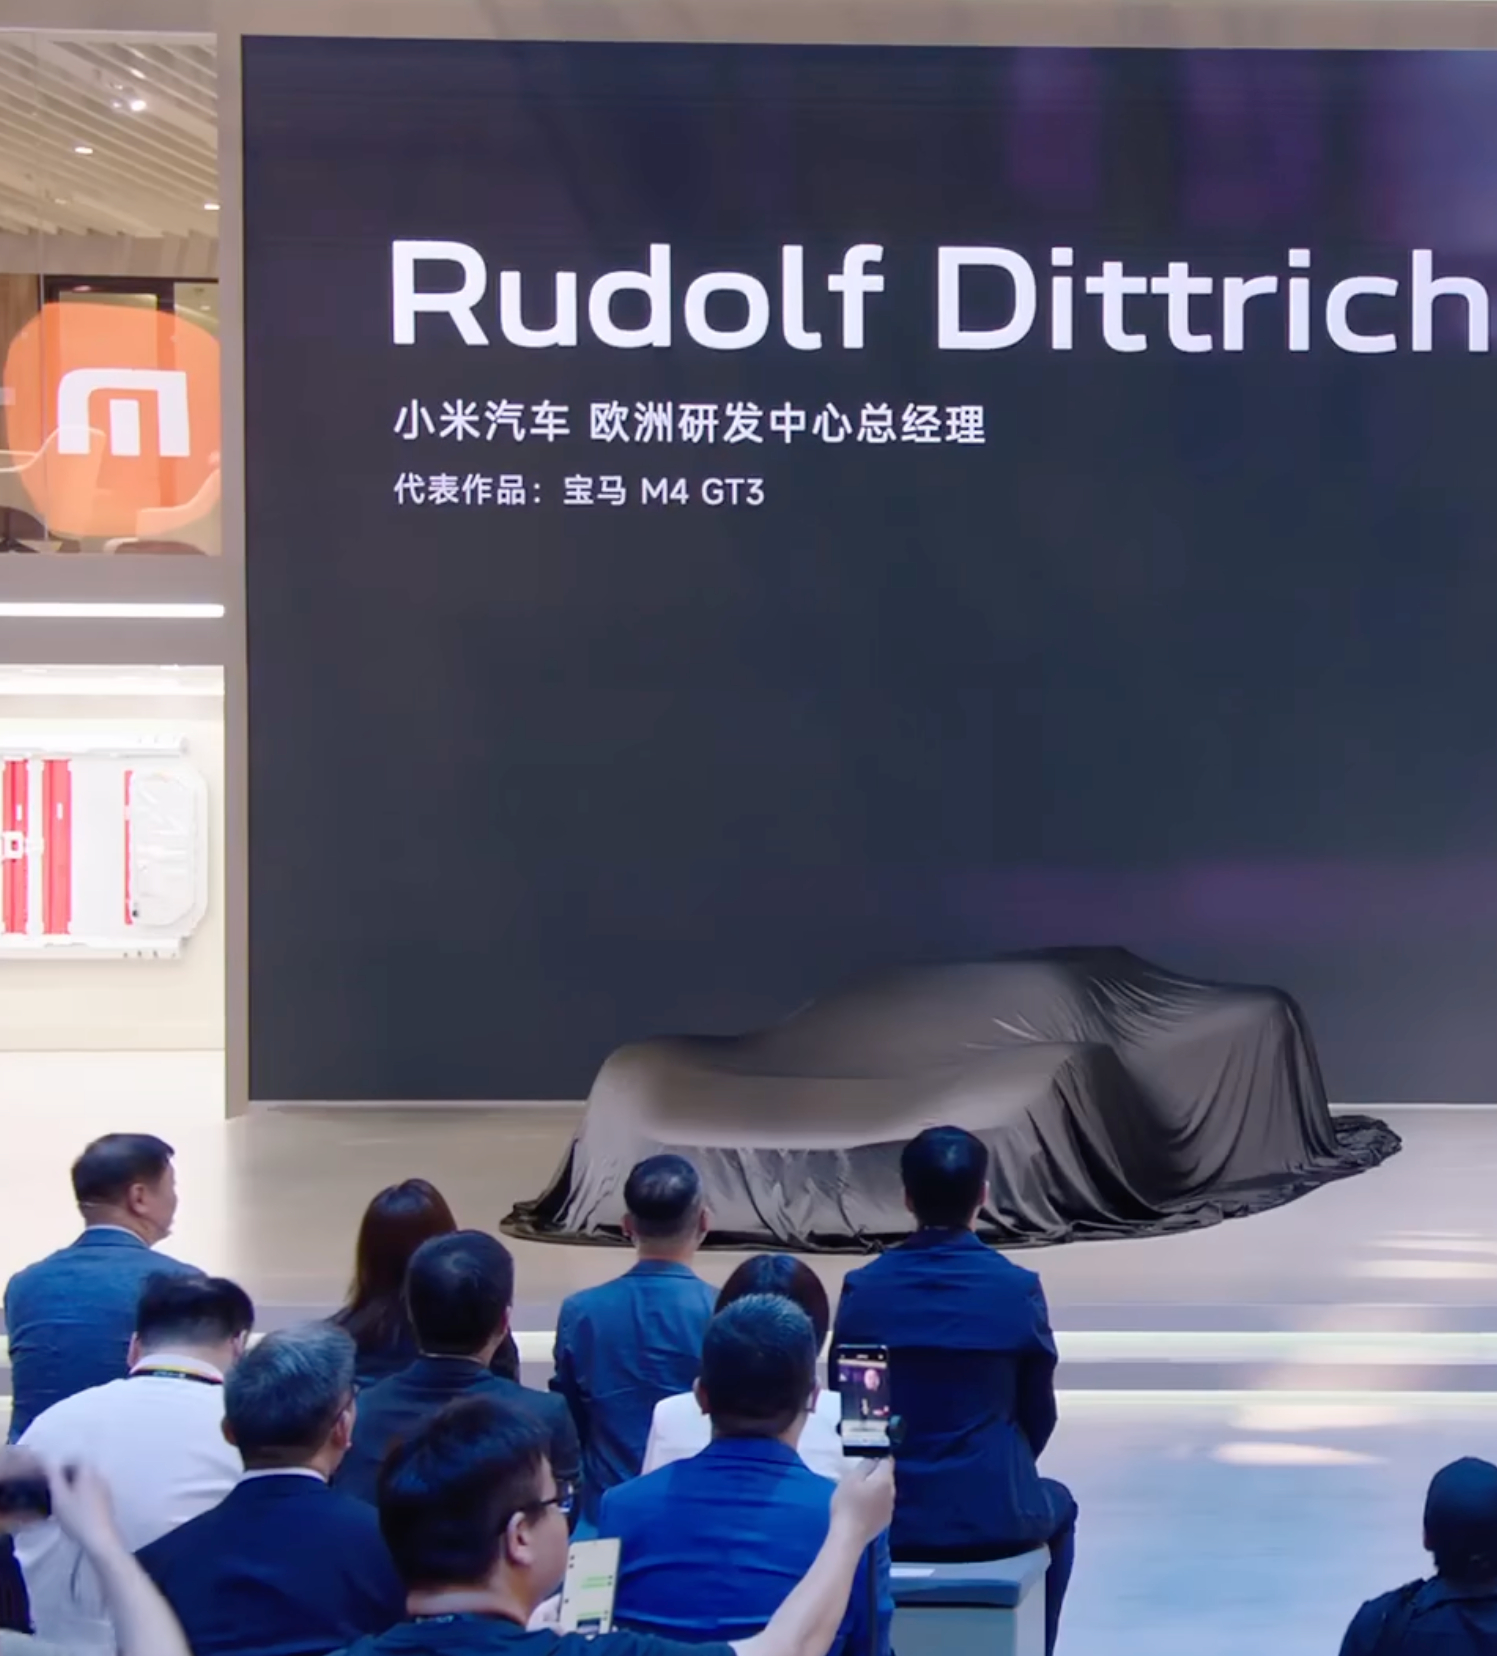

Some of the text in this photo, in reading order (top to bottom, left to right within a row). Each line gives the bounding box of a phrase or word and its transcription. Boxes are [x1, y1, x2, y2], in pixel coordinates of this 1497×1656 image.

[391, 239, 1490, 354] Rudolf Dittrich
[393, 398, 987, 444] 小米汽车 欧洲研发中心总经理
[641, 477, 689, 505] M4
[701, 477, 766, 506] GT3
